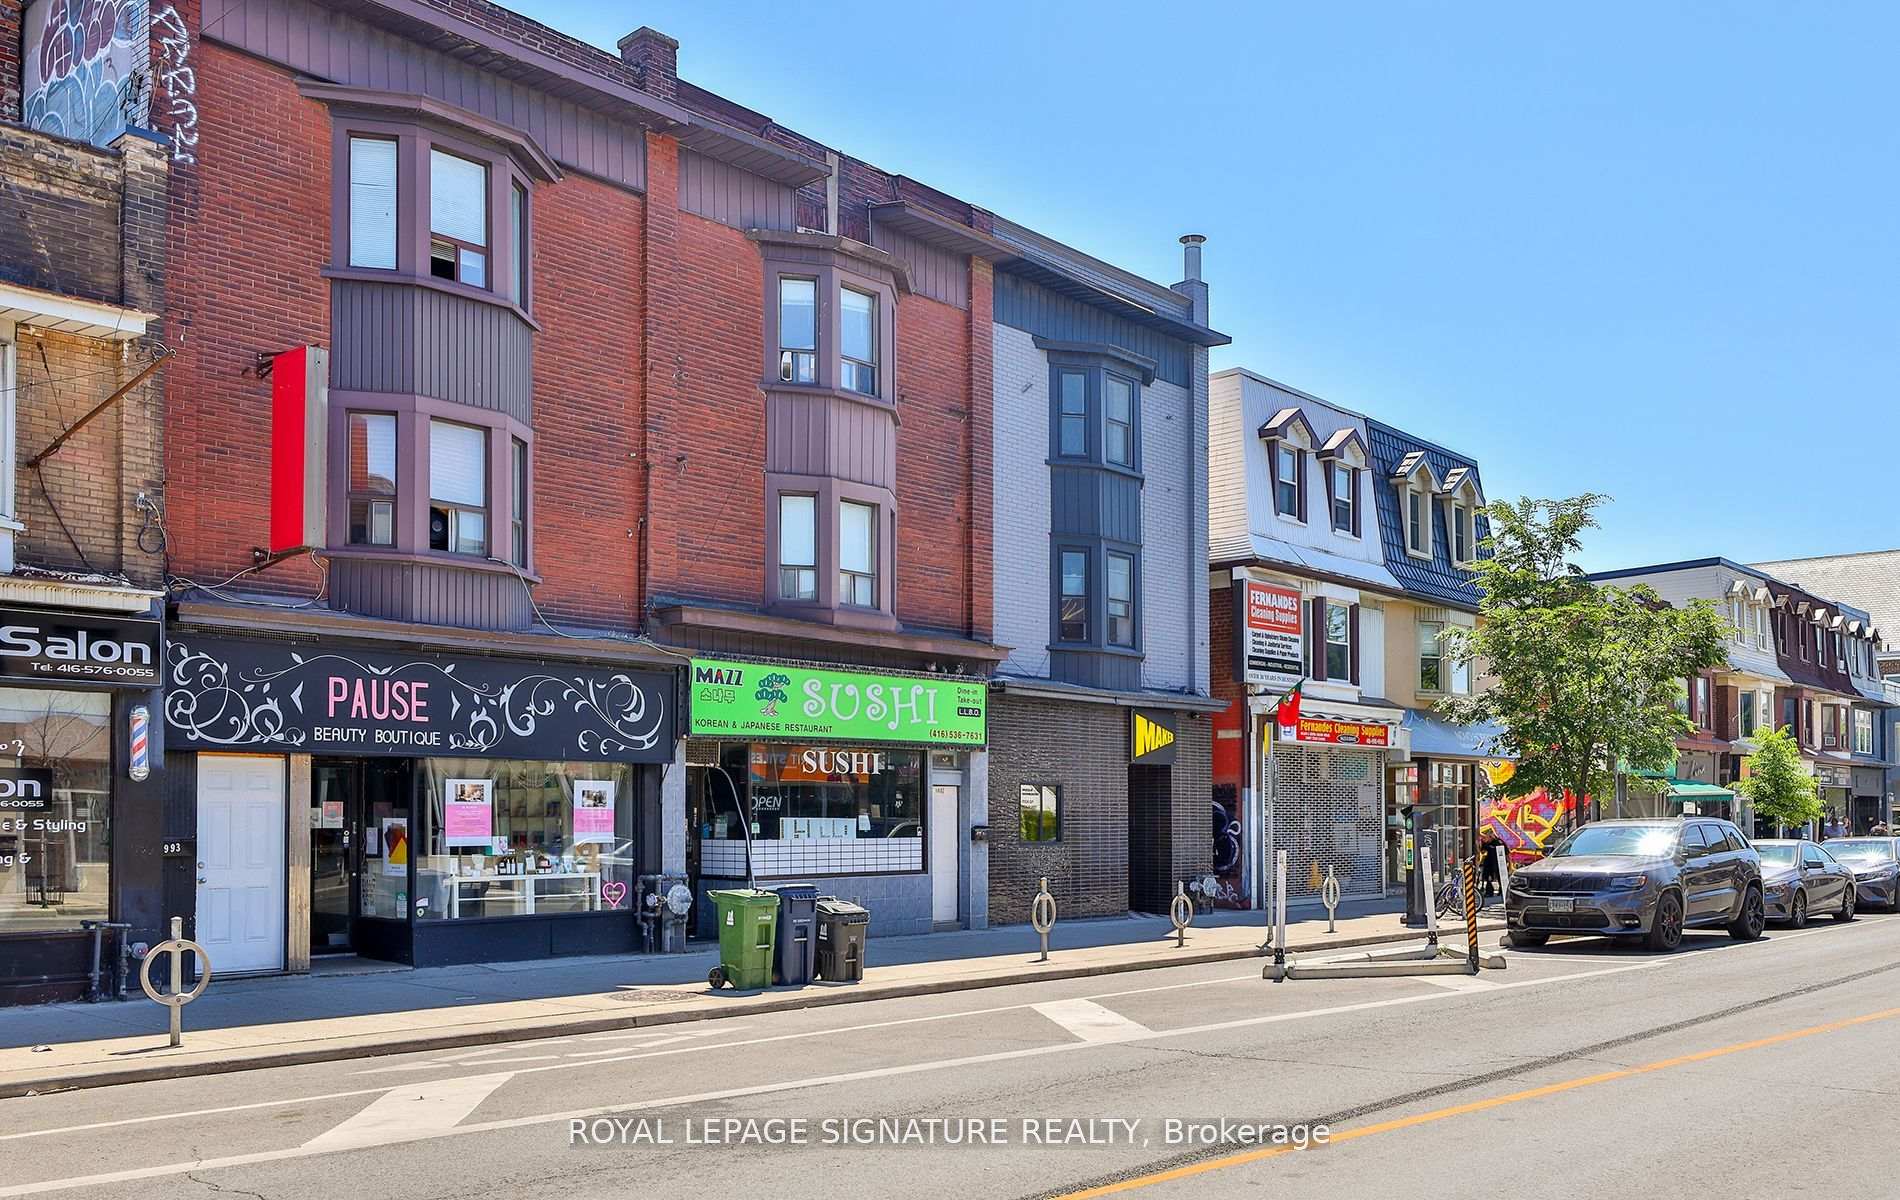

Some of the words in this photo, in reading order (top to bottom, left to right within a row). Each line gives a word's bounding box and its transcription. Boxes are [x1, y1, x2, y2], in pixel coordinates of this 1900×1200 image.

[1250, 589, 1297, 611] FERNANDES
[1251, 605, 1275, 622] Cleaning
[1275, 609, 1297, 625] Supplies
[0, 625, 151, 665] Salon
[31, 662, 52, 673] Tel:
[57, 665, 154, 678] 416-576-0055
[695, 666, 744, 687] MAZZ
[328, 676, 430, 722] PAUSE
[700, 688, 736, 703] 소나무
[802, 678, 938, 730] SUSHI
[695, 718, 729, 729] KOREAN
[732, 720, 737, 729] &
[741, 721, 781, 731] JAPANESE
[784, 723, 833, 733] RESTAURANT
[1300, 719, 1333, 733] Fernandes
[1334, 722, 1360, 736] Cleaning
[1361, 725, 1386, 738] Supplies
[314, 727, 367, 742] BEAUTY
[375, 729, 441, 746] BOUTIQUE
[802, 750, 881, 774] SUSHI
[751, 796, 783, 807] OPEN
[16, 819, 28, 830] &
[33, 819, 87, 834] Styling
[163, 842, 181, 854] 993
[19, 853, 31, 864] &
